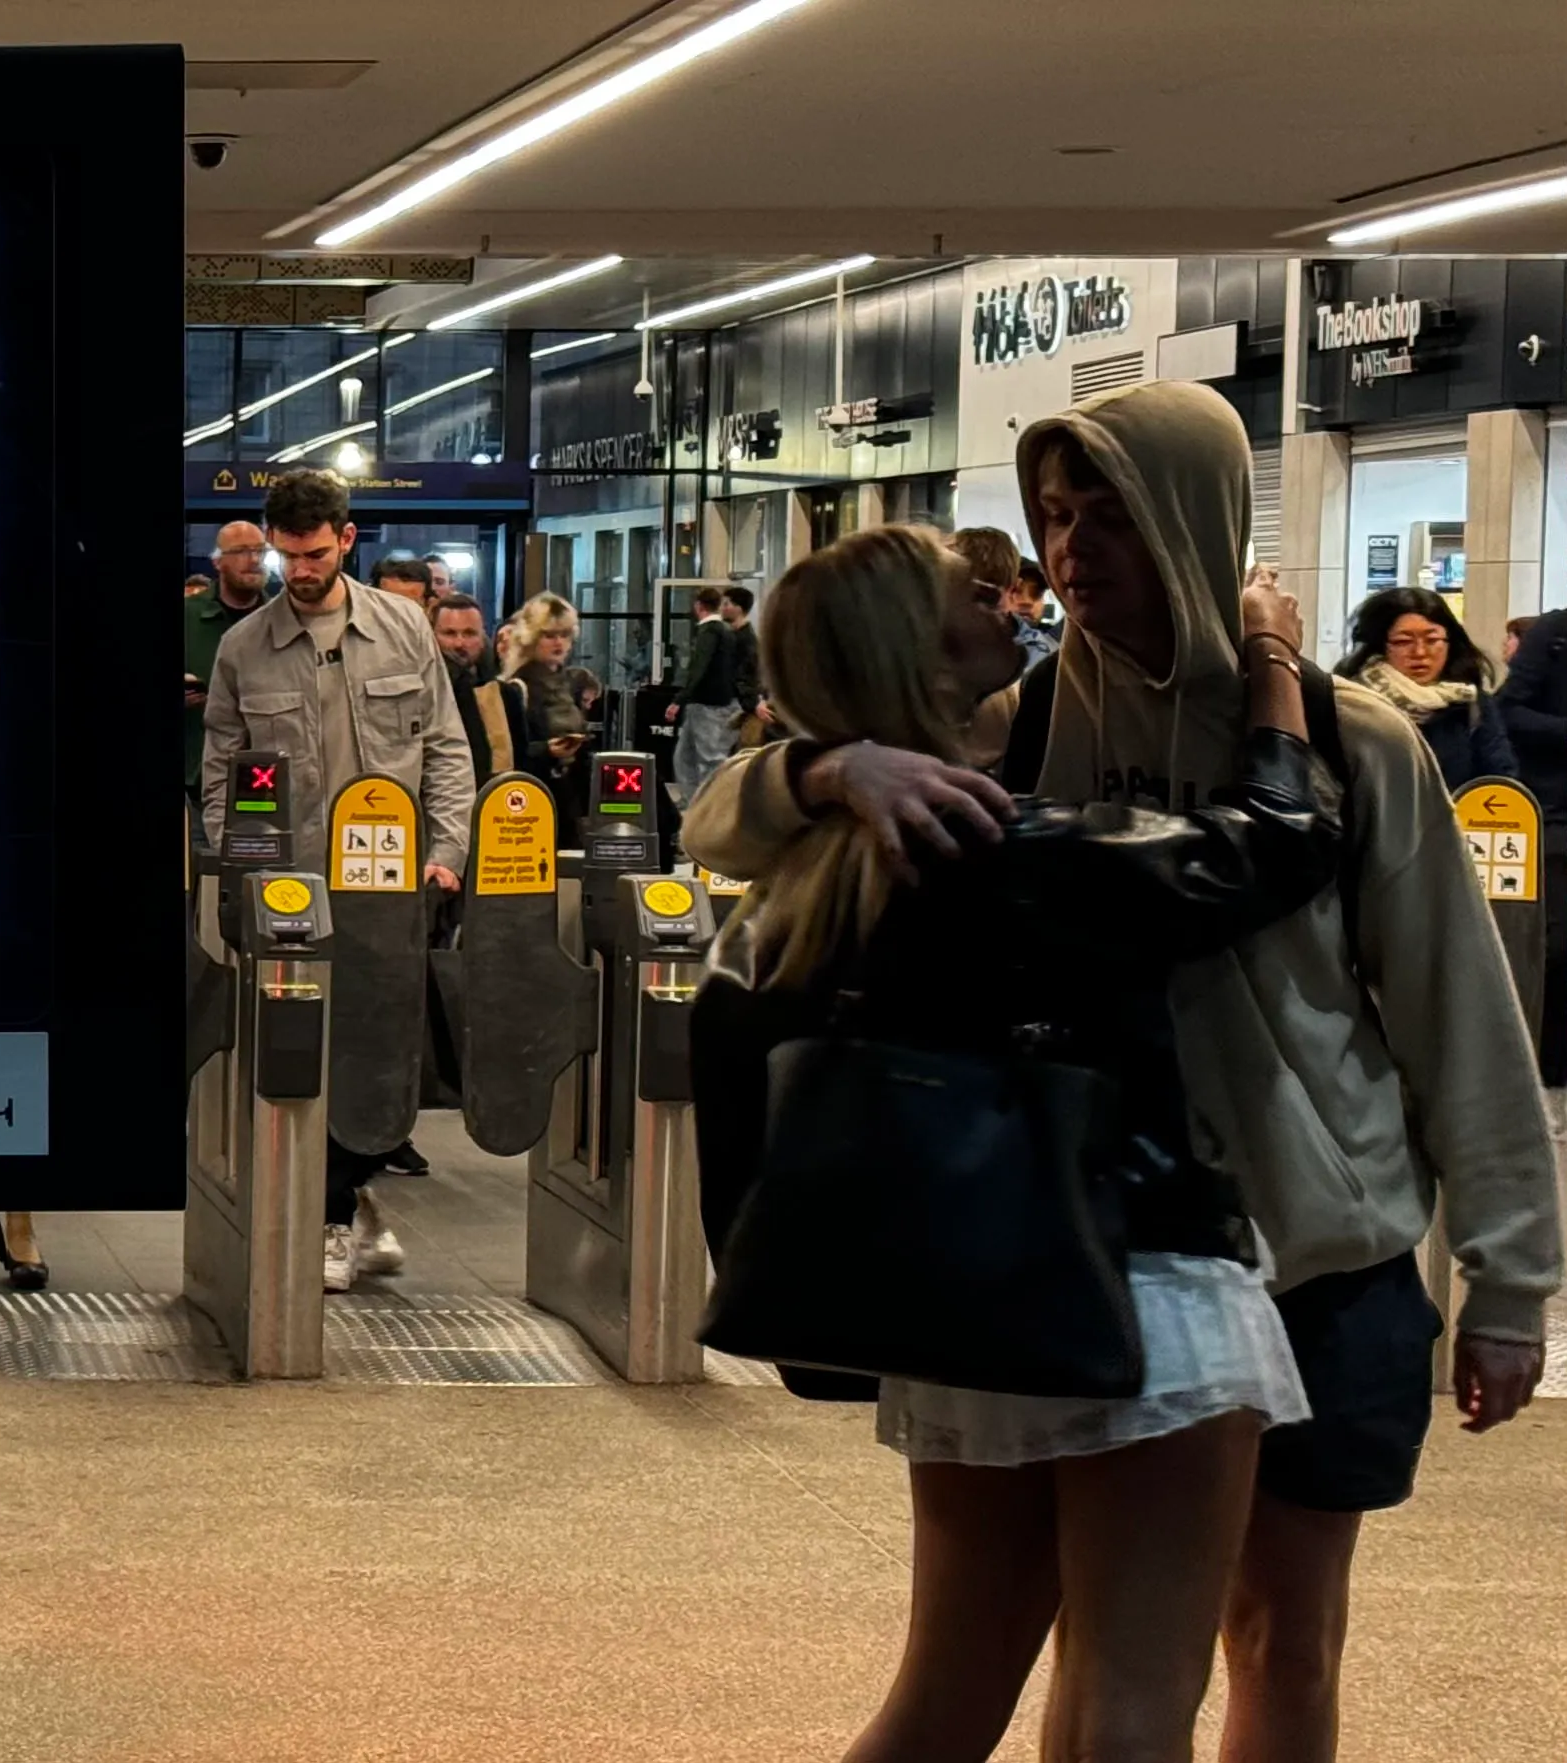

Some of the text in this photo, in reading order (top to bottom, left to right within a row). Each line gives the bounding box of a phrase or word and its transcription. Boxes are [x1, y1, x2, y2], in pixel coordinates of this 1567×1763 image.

[1317, 293, 1422, 351] TheBookshop
[250, 471, 278, 488] Wa
[359, 479, 391, 488] Station
[649, 725, 674, 737] THE
[349, 812, 400, 822] Assistance
